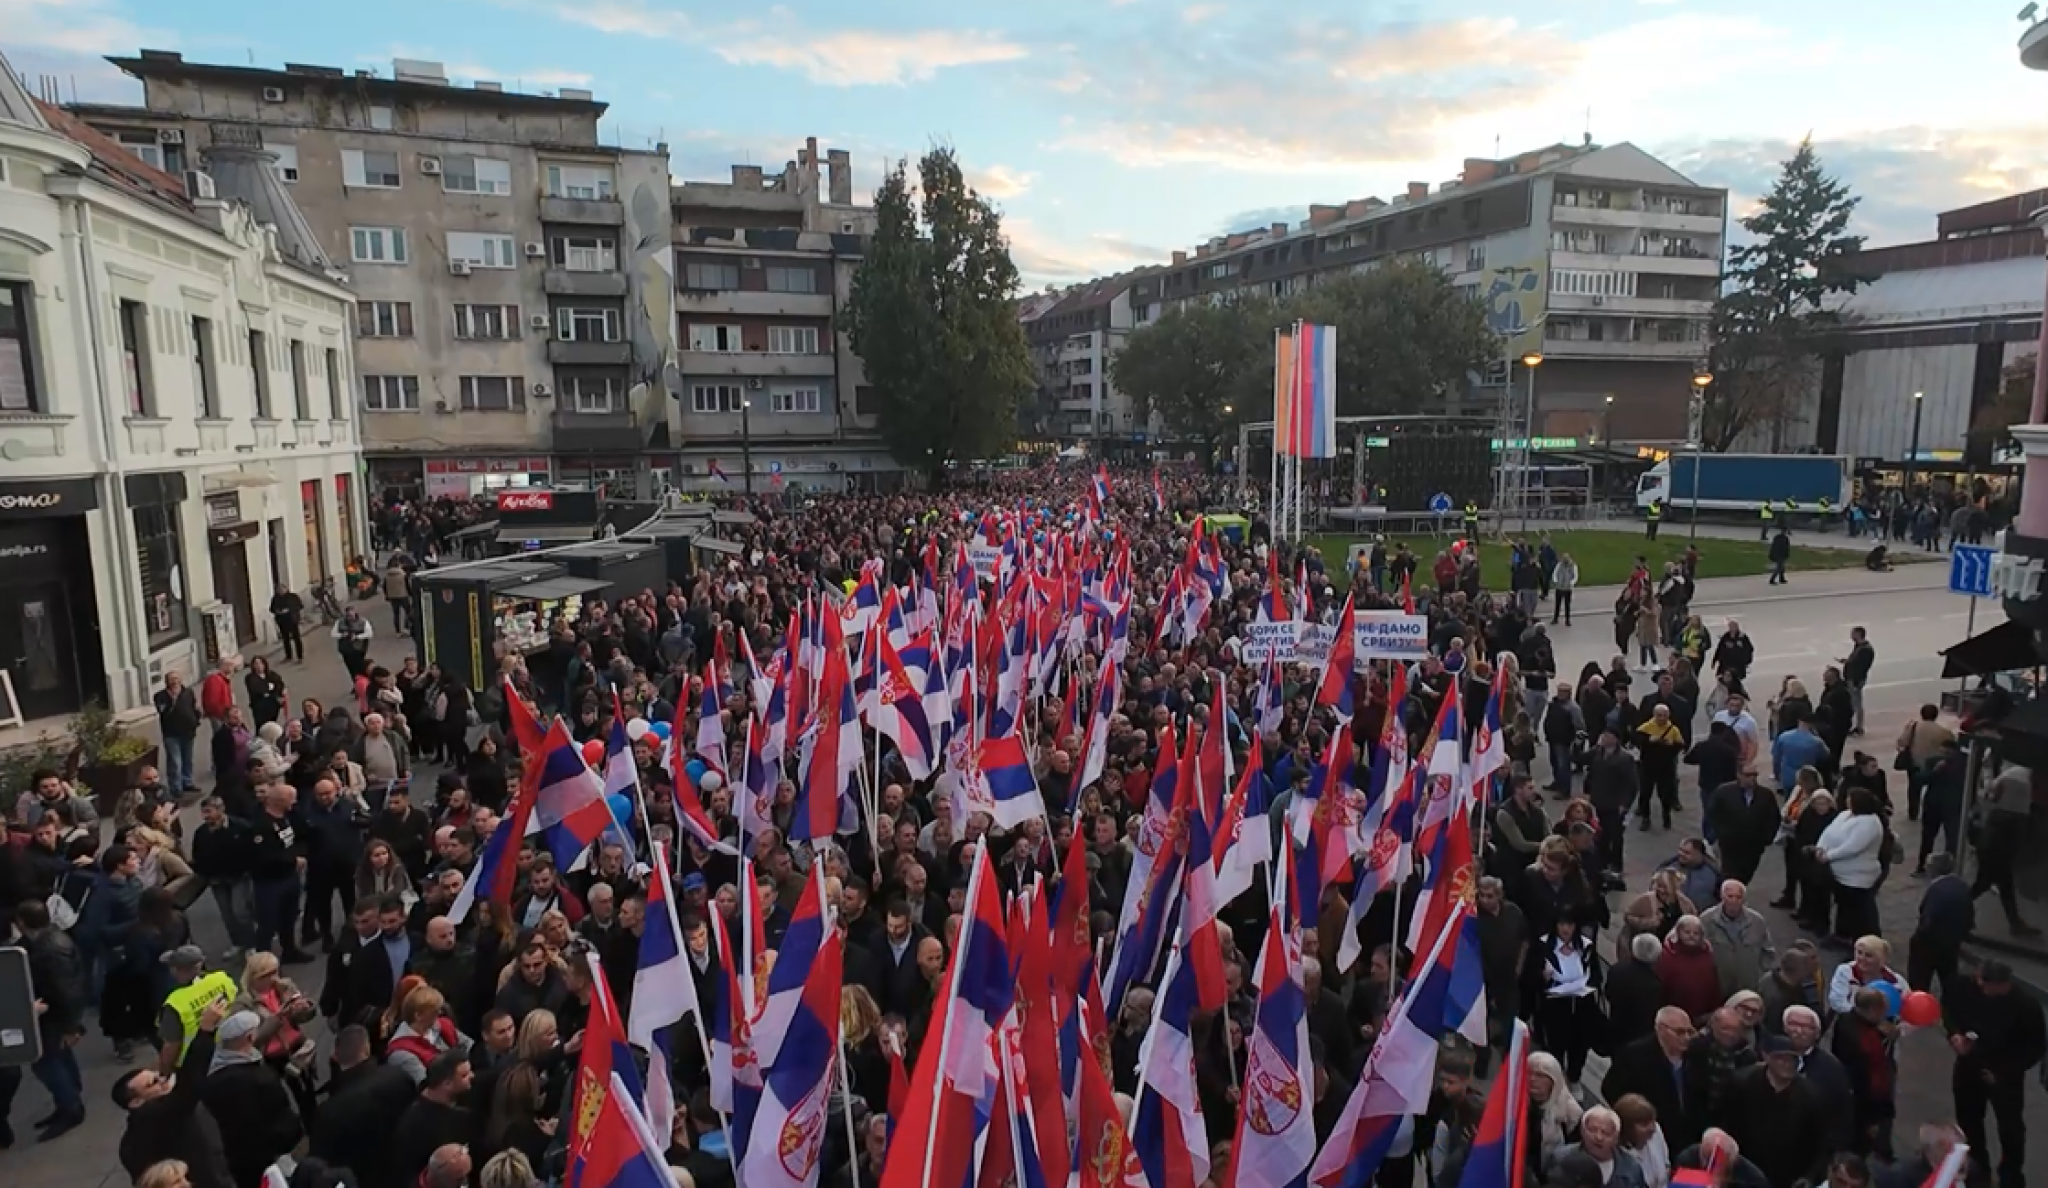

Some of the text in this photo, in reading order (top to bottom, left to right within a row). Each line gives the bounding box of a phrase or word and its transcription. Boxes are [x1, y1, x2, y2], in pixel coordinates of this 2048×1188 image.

[0, 494, 58, 509] oma
[1280, 624, 1295, 634] СЕ
[1357, 623, 1421, 635] НЕ ДАМО
